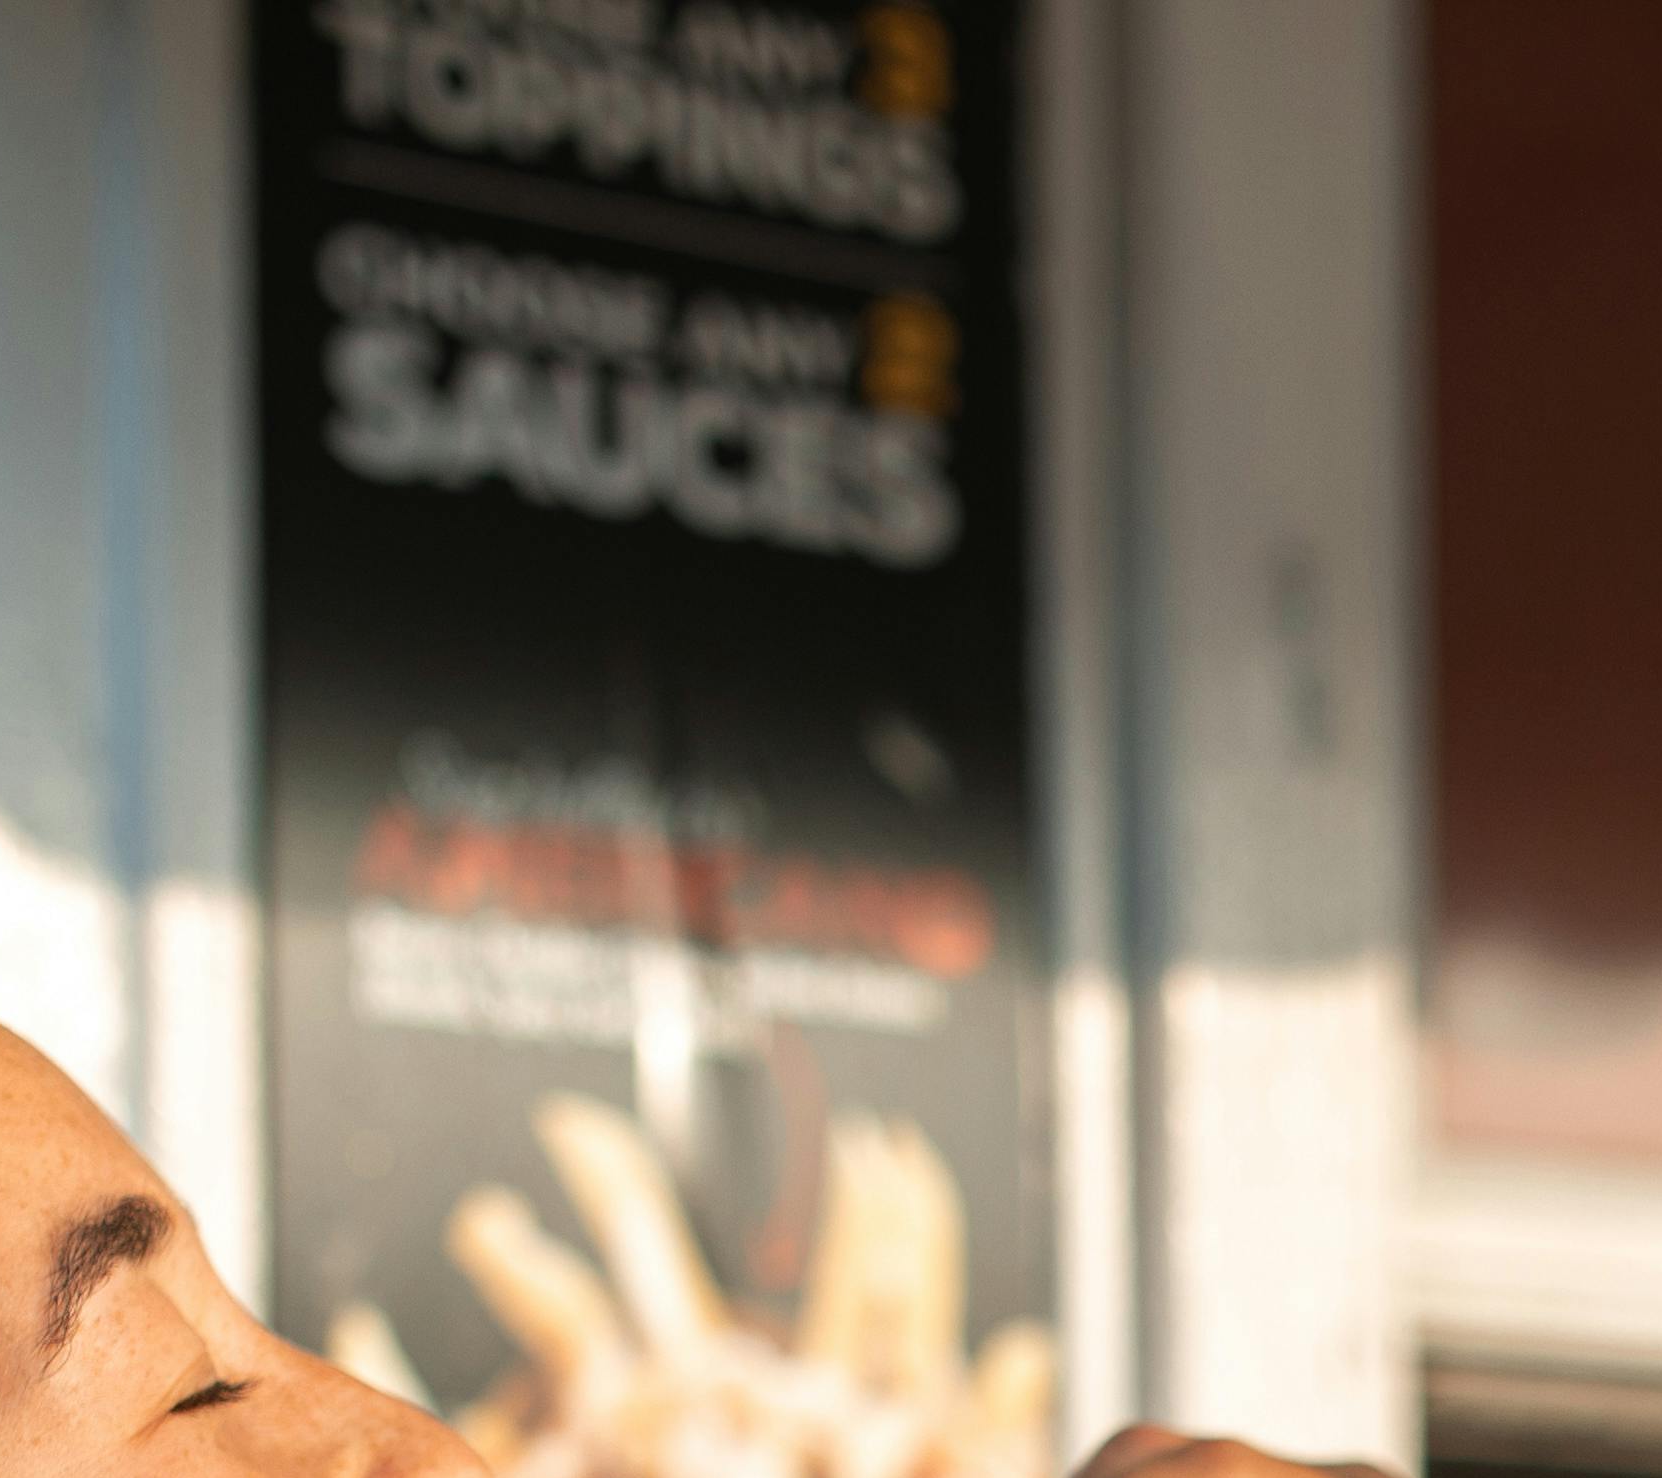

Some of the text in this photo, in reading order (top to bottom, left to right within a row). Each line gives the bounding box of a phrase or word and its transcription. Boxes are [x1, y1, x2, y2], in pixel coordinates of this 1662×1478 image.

[333, 14, 952, 236] TOPPINGS
[322, 230, 658, 354] CHOOSE
[690, 312, 842, 382] ANY
[330, 322, 954, 562] SAUCES
